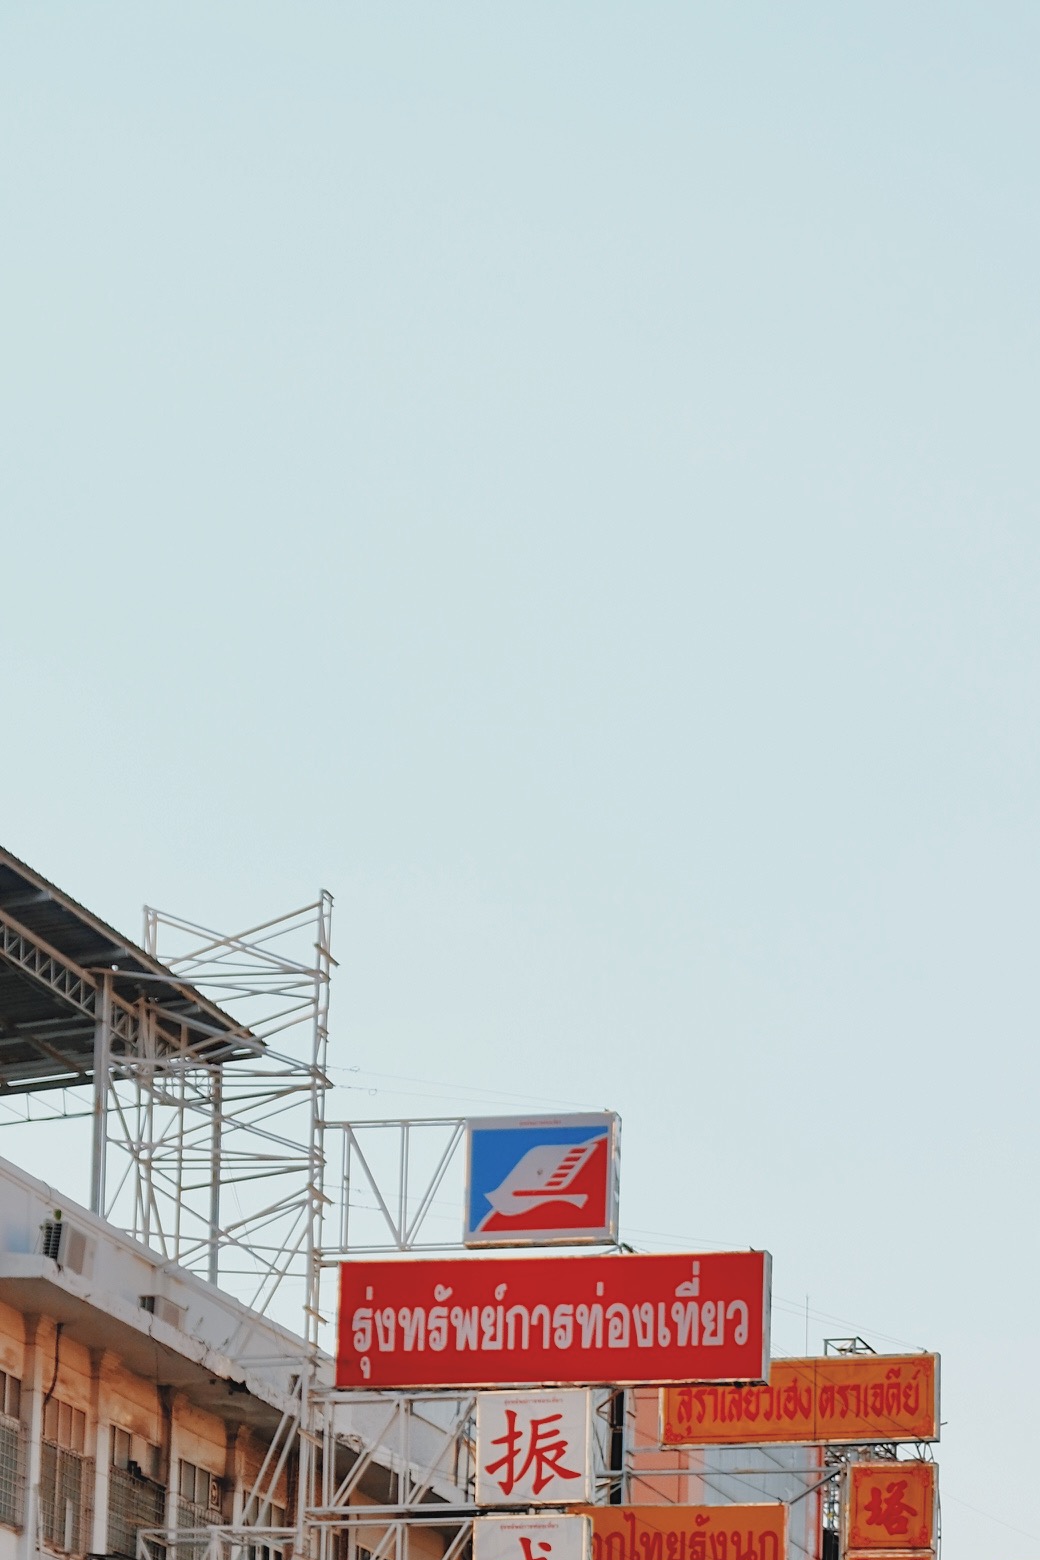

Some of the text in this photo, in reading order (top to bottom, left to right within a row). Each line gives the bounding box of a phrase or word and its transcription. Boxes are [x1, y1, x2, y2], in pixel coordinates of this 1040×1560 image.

[351, 1262, 749, 1379] รุ่งทรัพย์การท่องเที่ยว
